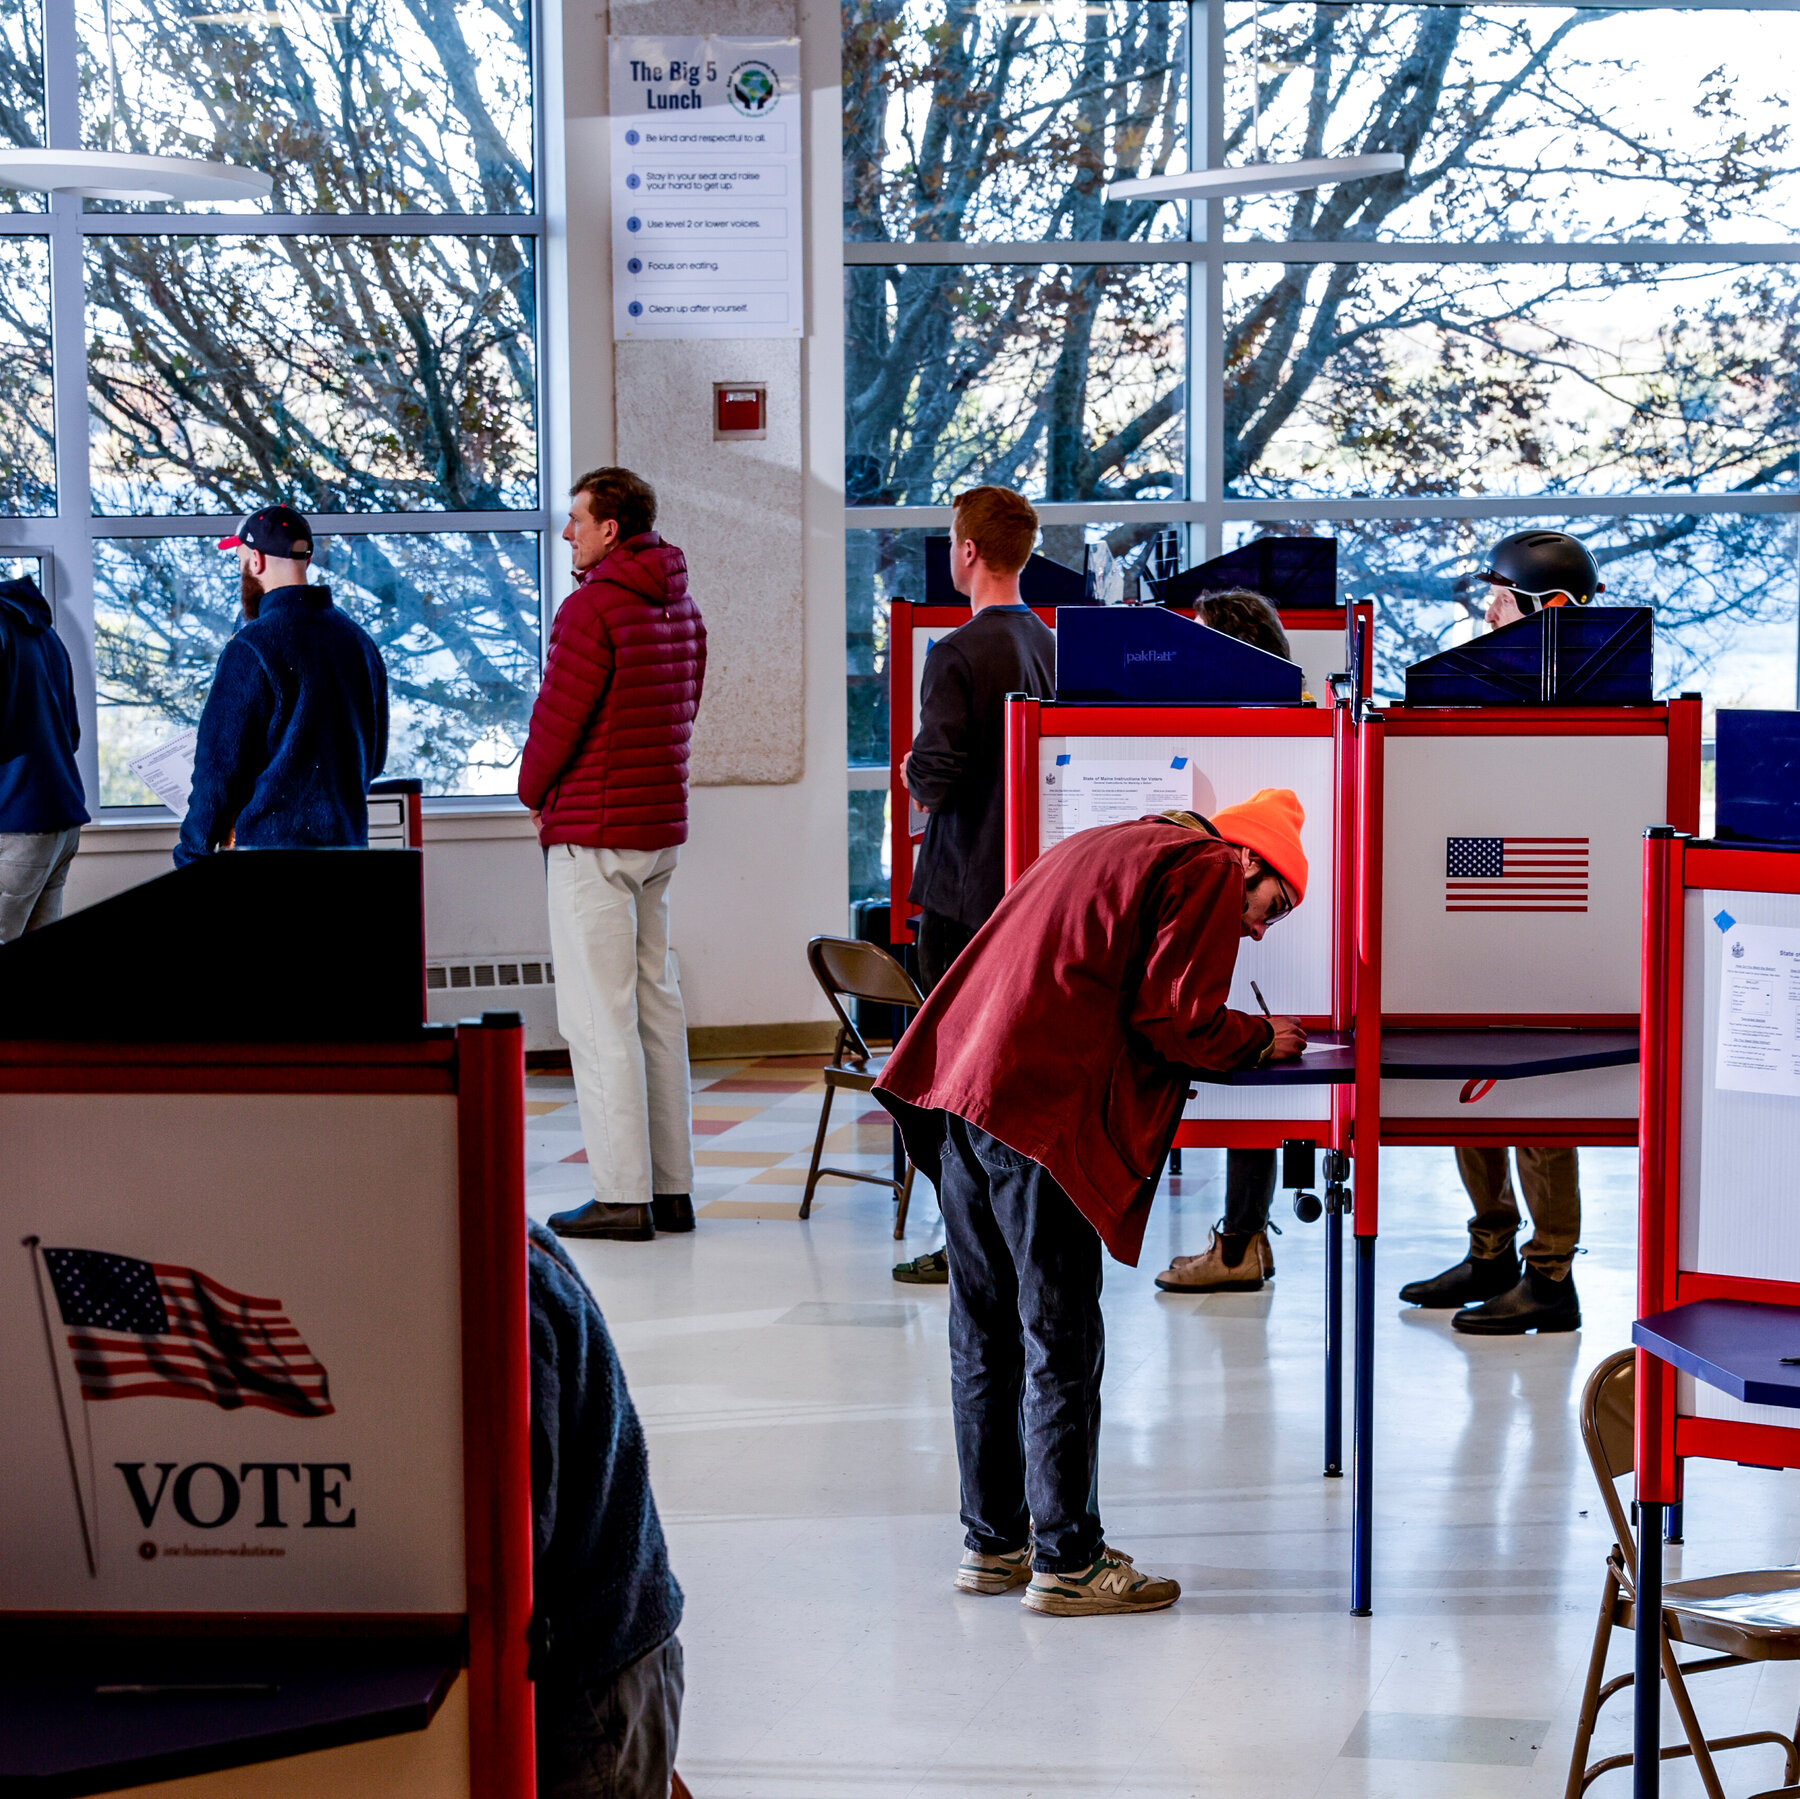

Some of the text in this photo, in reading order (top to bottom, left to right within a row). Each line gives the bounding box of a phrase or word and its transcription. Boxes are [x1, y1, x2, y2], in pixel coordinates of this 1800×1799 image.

[630, 61, 717, 86] The Big 5
[647, 89, 702, 109] Lunch
[646, 134, 657, 142] Be
[659, 134, 678, 142] kind
[679, 134, 697, 142] and
[699, 134, 742, 143] respectful
[744, 134, 753, 142] to
[646, 172, 760, 181] Stay in your seat and raise
[646, 182, 666, 191] your
[668, 182, 692, 190] hand
[693, 182, 702, 190] to
[703, 182, 719, 191] get
[647, 220, 664, 228] Use
[665, 220, 685, 228] level
[687, 220, 692, 228] 2
[694, 220, 703, 228] or
[704, 220, 729, 228] lower
[731, 220, 760, 228] voices.
[648, 261, 675, 270] Focus
[676, 262, 687, 270] on
[689, 261, 719, 271] eating.
[648, 304, 675, 313] Clean
[676, 305, 688, 314] up
[690, 304, 710, 313] after
[712, 303, 748, 314] yourself.
[114, 1462, 356, 1528] VOTE
[1100, 1572, 1128, 1595] N
